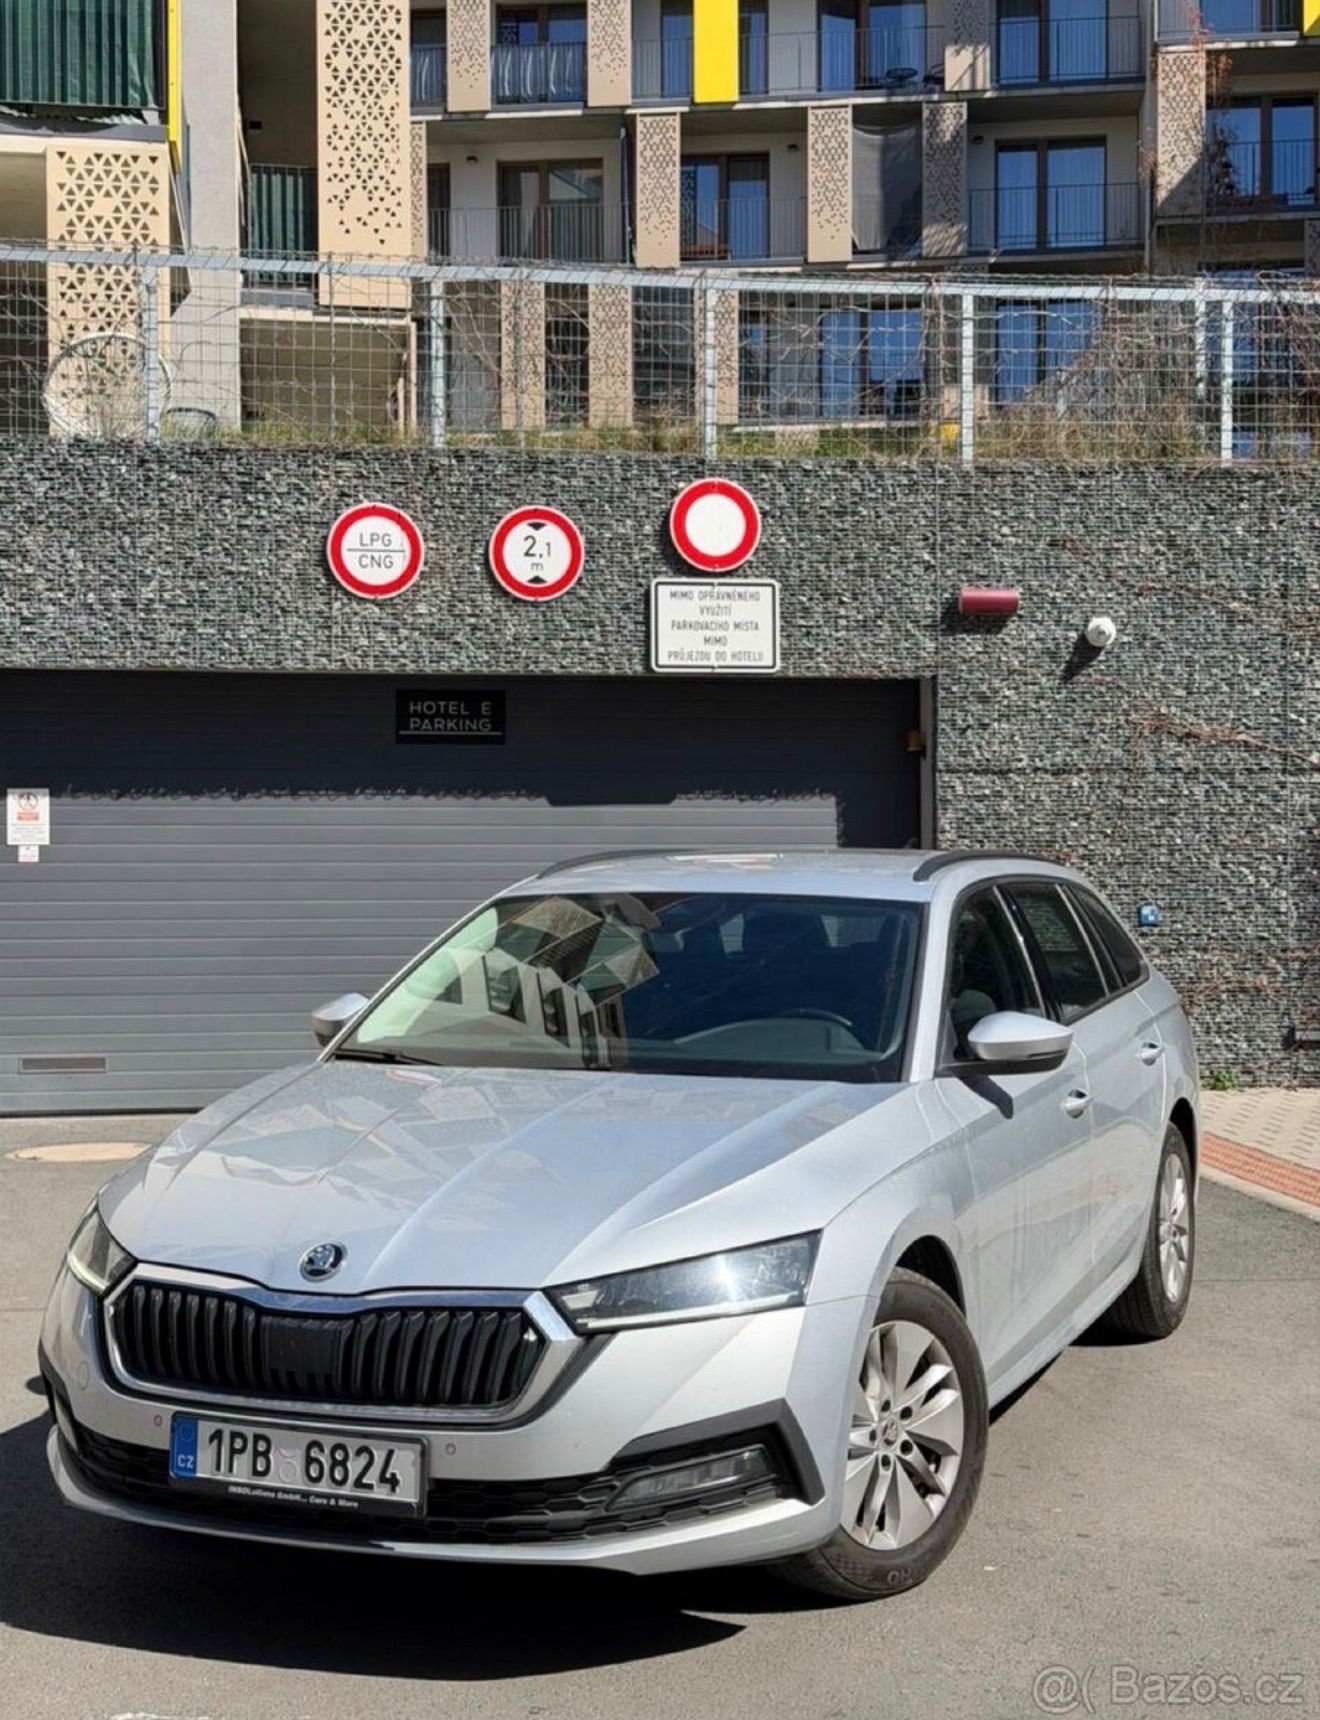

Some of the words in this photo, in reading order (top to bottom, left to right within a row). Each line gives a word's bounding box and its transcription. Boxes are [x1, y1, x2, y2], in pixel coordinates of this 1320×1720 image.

[359, 532, 393, 547] LPG
[358, 554, 394, 569] CNG
[530, 562, 544, 571] m
[669, 590, 694, 600] MIMO
[703, 635, 728, 646] MIMO
[715, 650, 727, 661] DO
[731, 650, 764, 662] HOTELU
[409, 700, 469, 715] HOTEL
[480, 701, 492, 715] E
[409, 717, 492, 731] PARKING
[177, 1454, 195, 1468] CZ
[208, 1428, 273, 1478] 1PB
[304, 1439, 401, 1494] 6824
